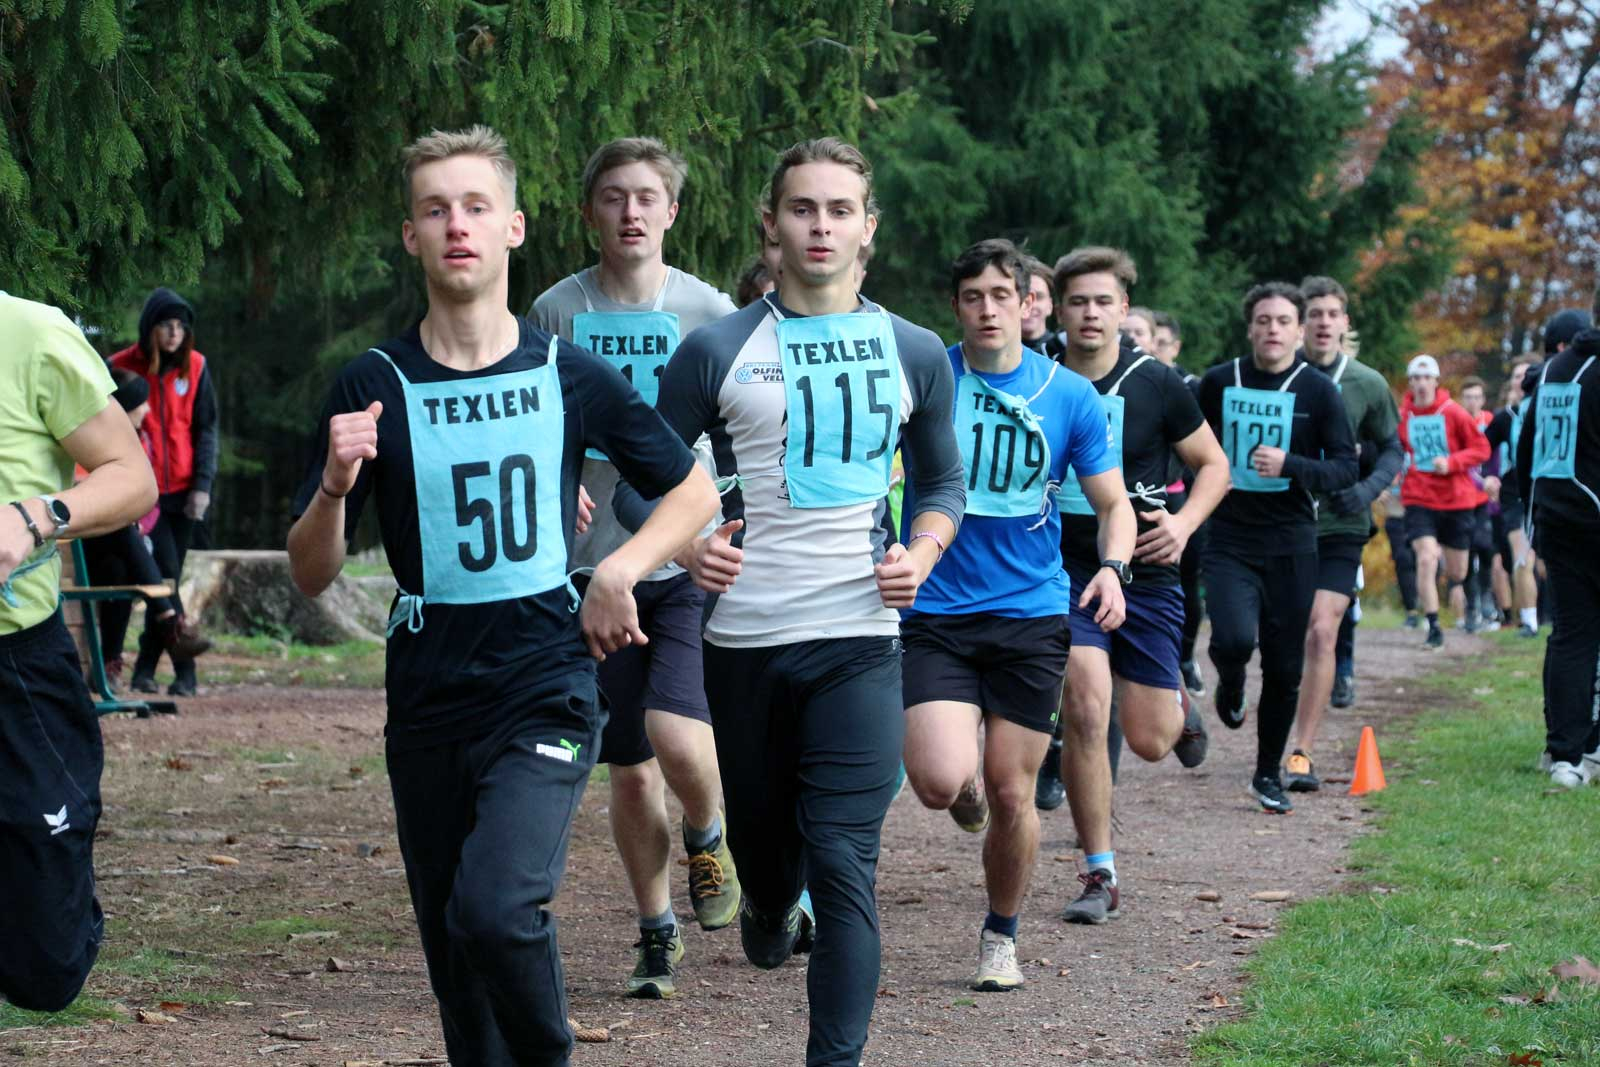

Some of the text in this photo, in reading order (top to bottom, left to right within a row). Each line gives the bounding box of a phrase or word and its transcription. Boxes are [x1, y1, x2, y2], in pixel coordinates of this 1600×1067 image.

[589, 335, 668, 355] TEXLEN
[787, 337, 884, 365] TEXLEN
[423, 386, 541, 425] TEXLEN
[795, 369, 893, 468] 115
[1231, 400, 1282, 416] TEXLEN
[968, 422, 1045, 493] 109
[451, 454, 537, 572] 50
